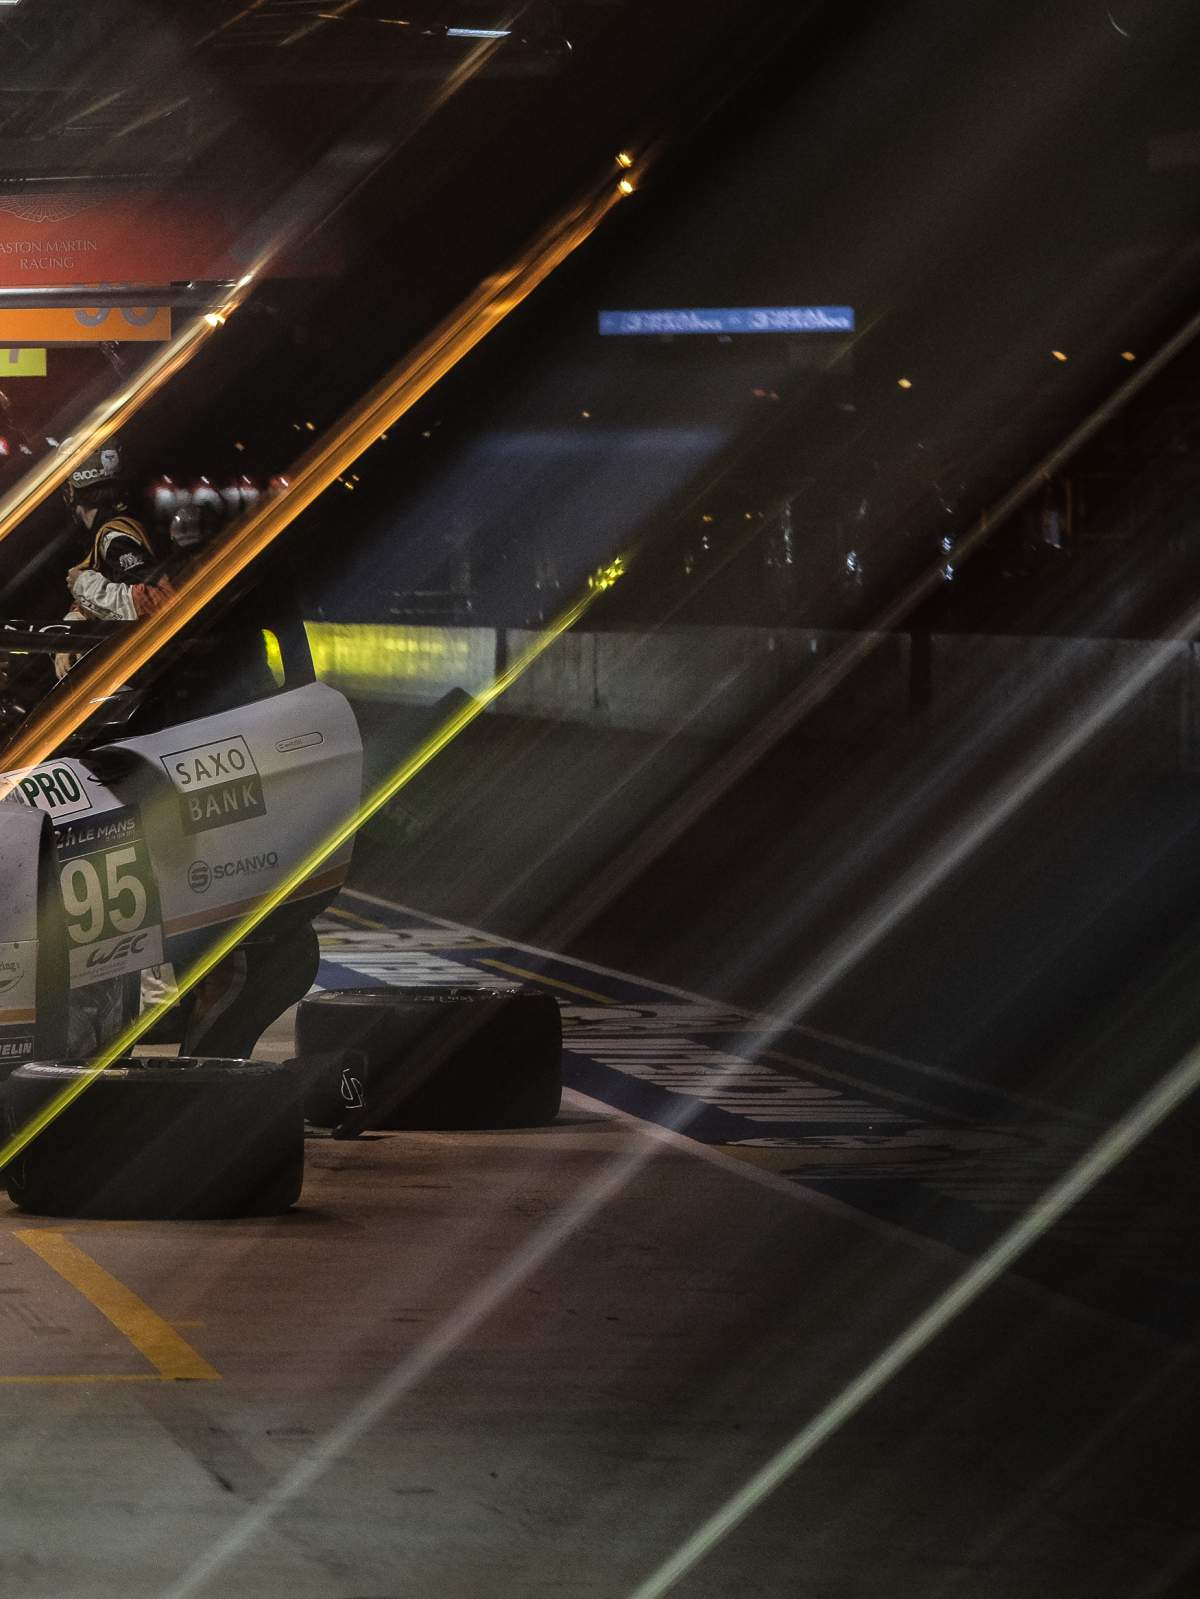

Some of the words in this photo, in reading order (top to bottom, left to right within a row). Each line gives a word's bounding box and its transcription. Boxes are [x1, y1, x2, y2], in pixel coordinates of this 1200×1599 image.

[46, 239, 98, 252] MARTIN
[19, 256, 75, 270] RACING
[175, 749, 246, 785] SAXO
[21, 767, 81, 808] PRO
[189, 783, 258, 821] BANK
[78, 829, 95, 844] LE
[97, 816, 136, 839] MANS
[214, 852, 279, 879] SCANVO
[60, 847, 146, 943] 95
